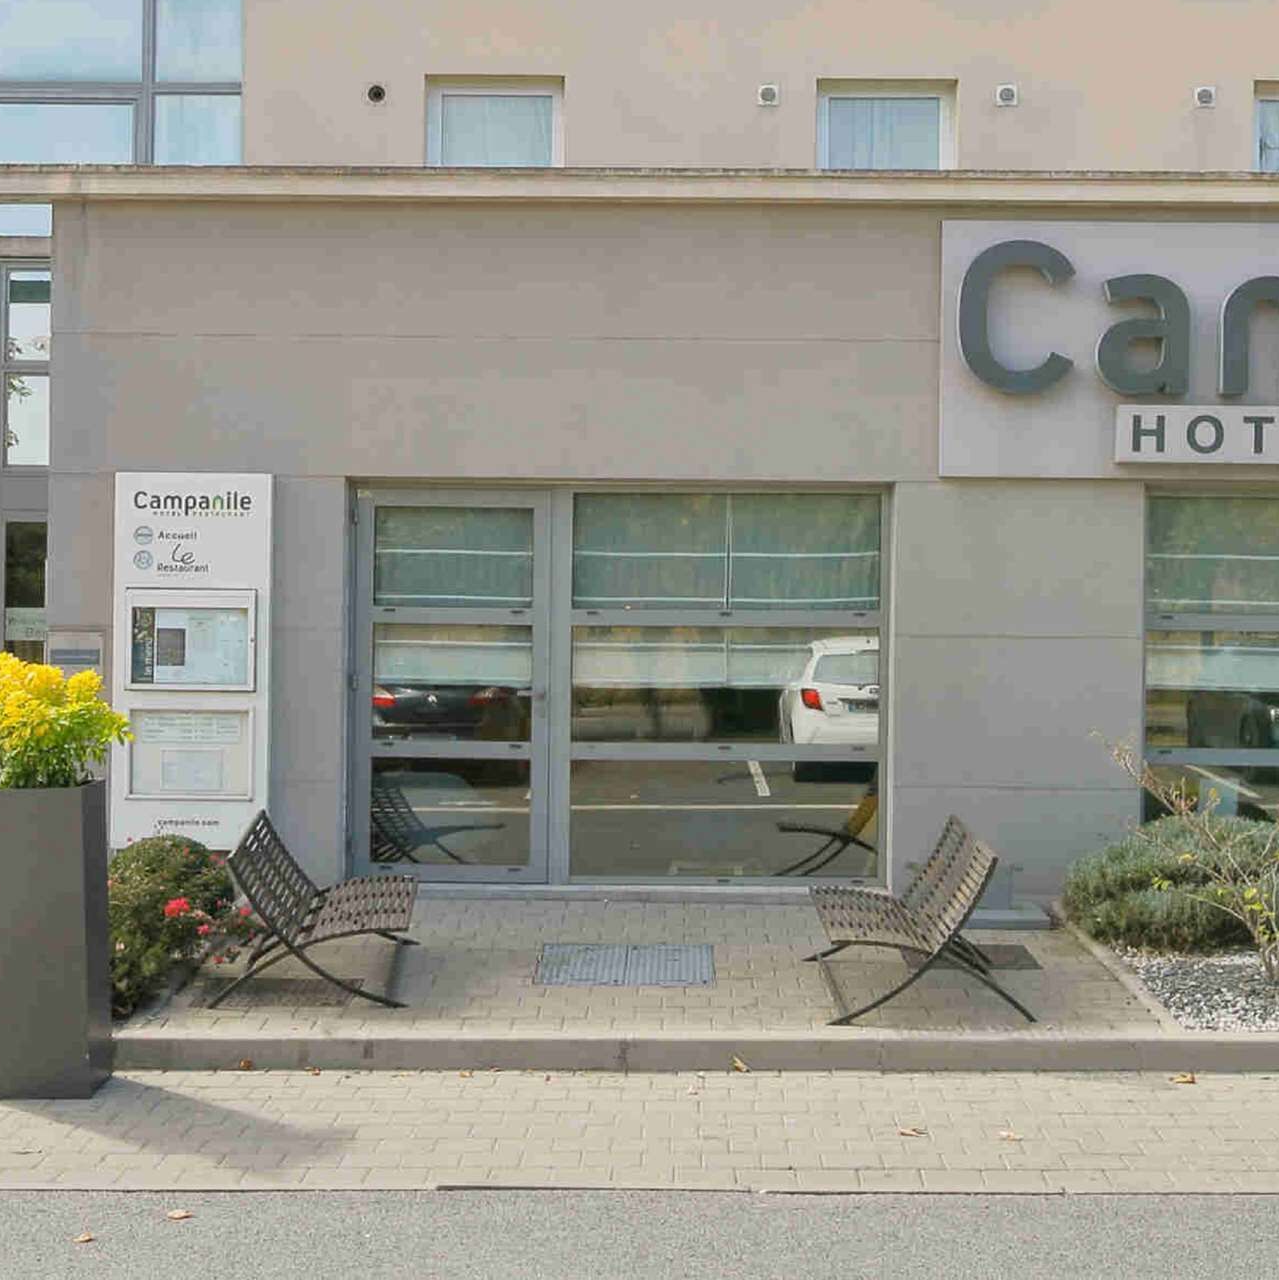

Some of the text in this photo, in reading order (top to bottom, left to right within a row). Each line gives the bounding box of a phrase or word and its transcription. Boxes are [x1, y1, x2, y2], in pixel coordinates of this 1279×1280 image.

[133, 490, 252, 516] Campanile
[158, 531, 197, 540] Accueil
[157, 563, 209, 573] Restaurant
